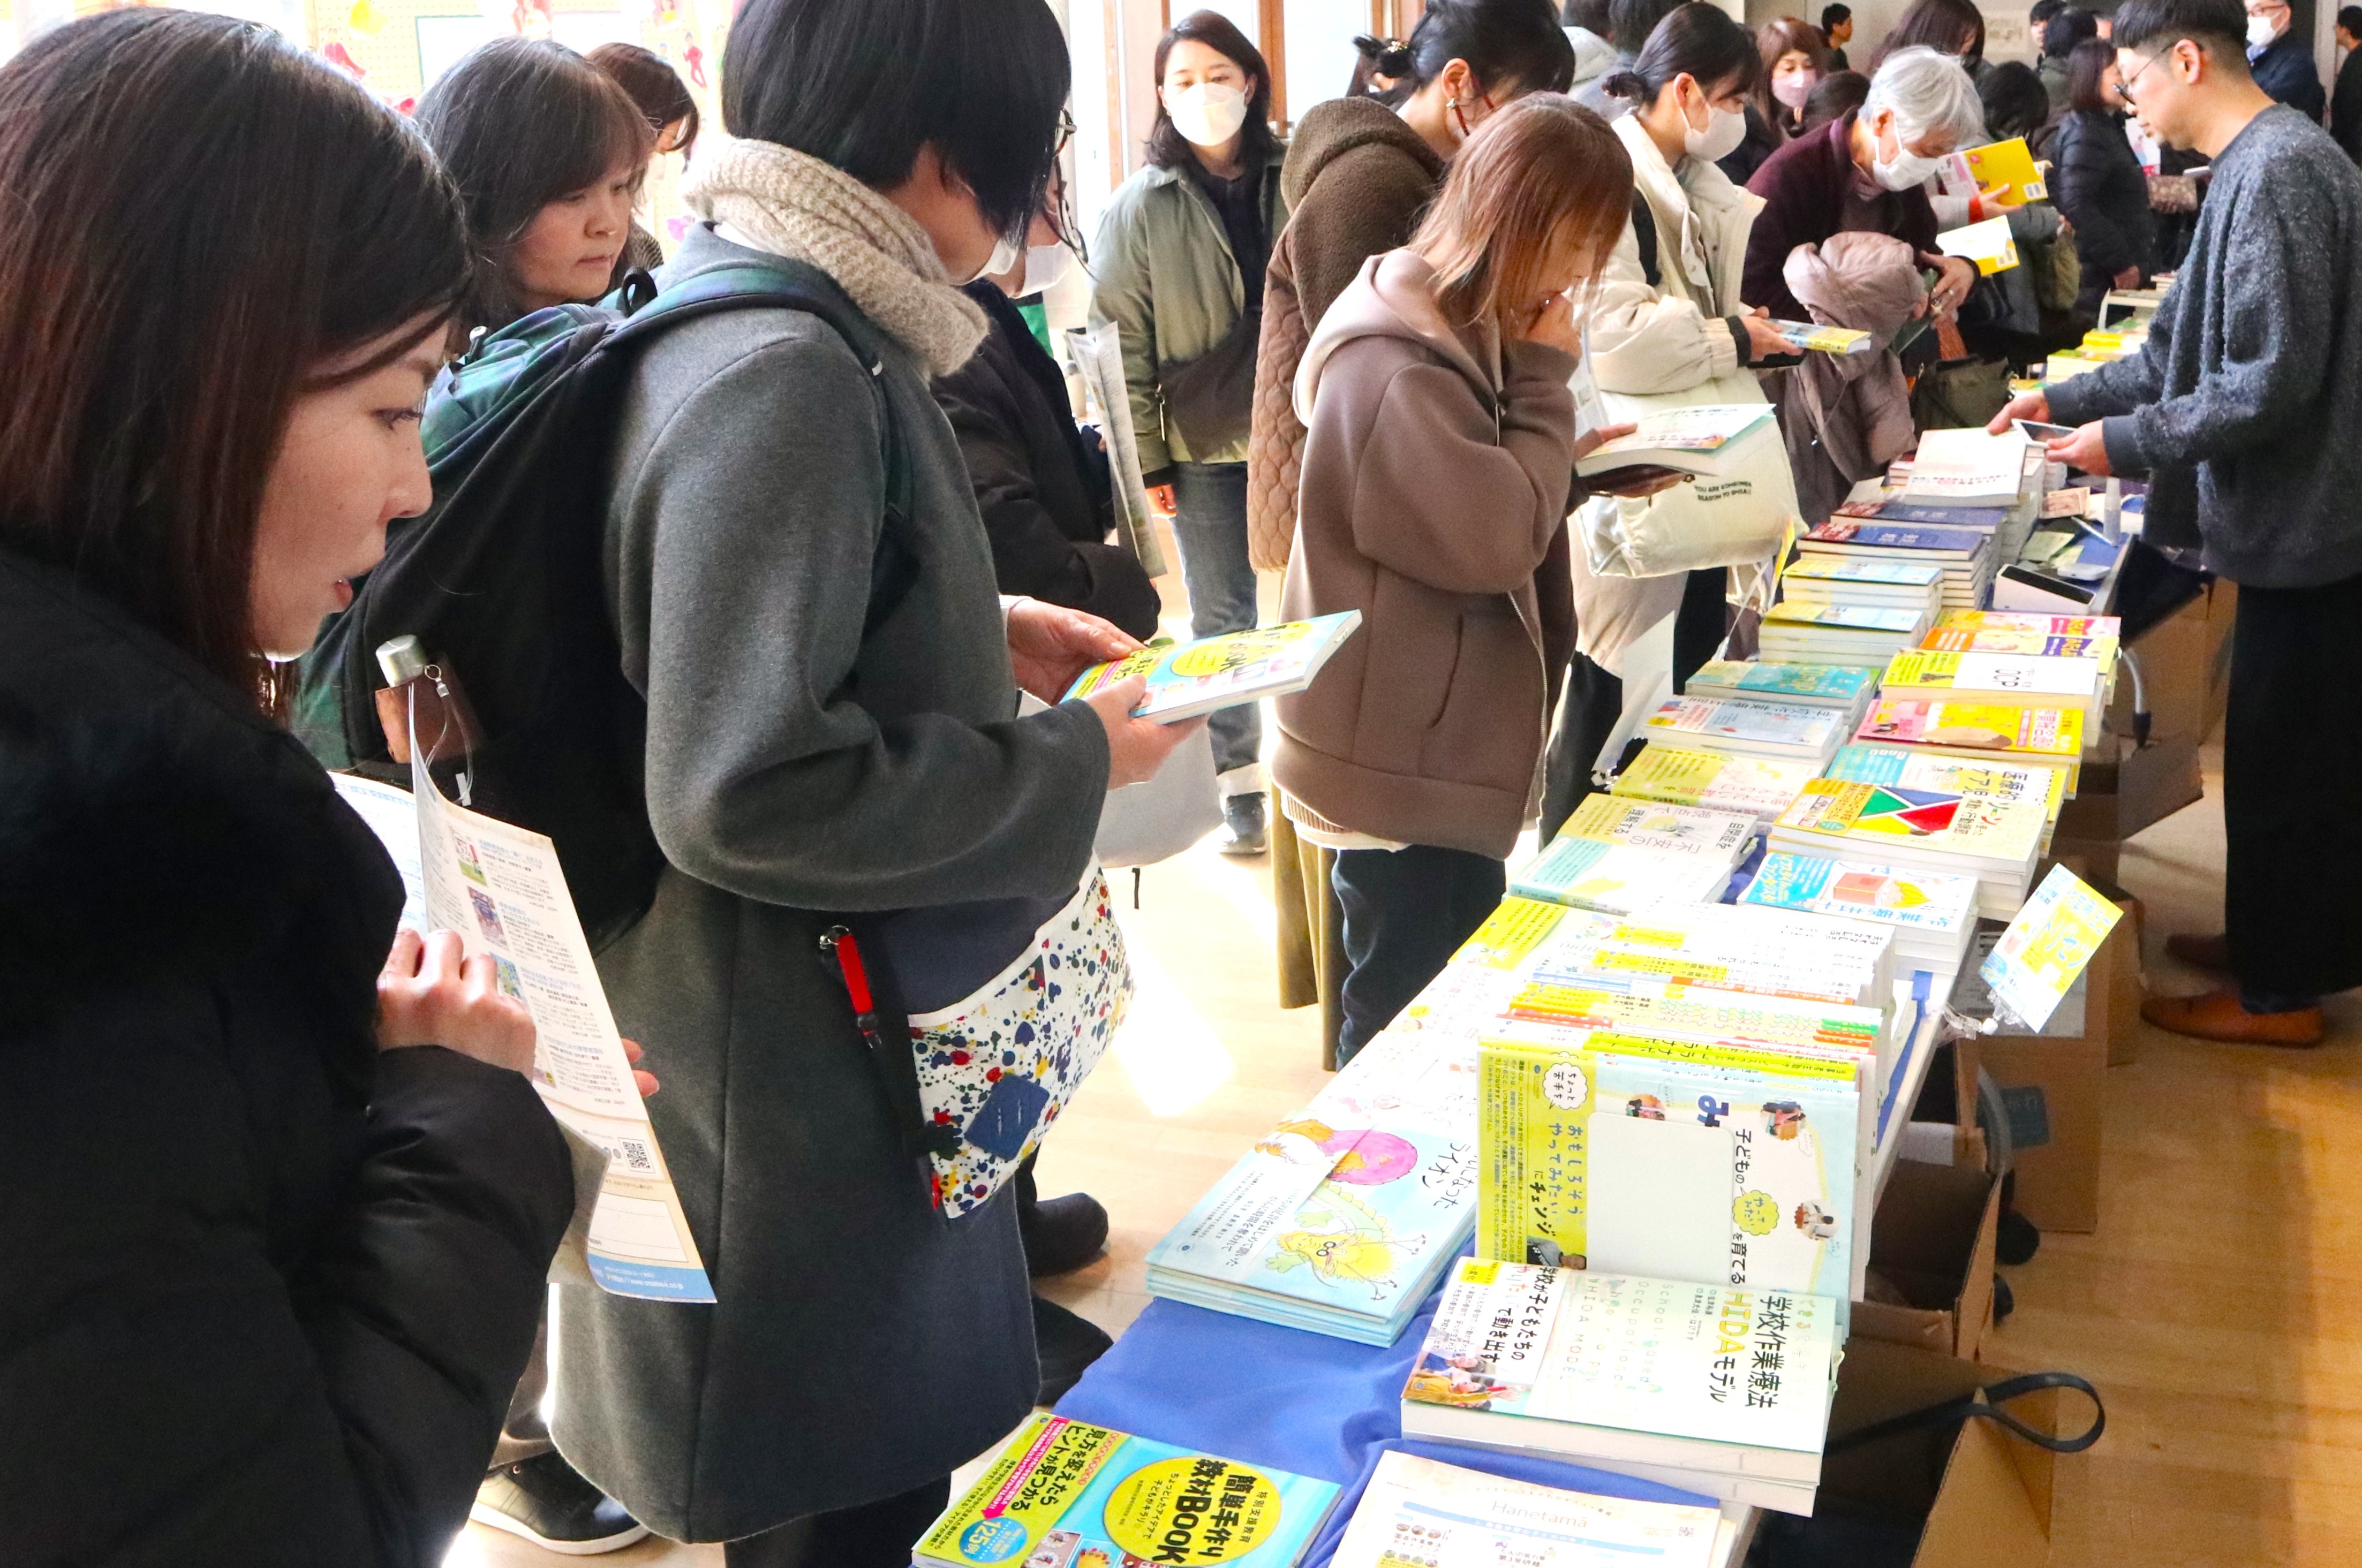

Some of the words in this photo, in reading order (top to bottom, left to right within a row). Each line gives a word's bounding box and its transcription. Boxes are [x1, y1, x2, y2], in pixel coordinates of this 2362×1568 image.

[1989, 668, 2023, 687] OCP
[1994, 771, 2029, 801] 医療的
[1612, 809, 1647, 834] 理解する
[1714, 822, 1746, 849] 自閉症を
[1552, 1070, 1564, 1099] 苦手を
[1567, 1073, 1576, 1101] ちょっと
[1422, 1143, 1473, 1188] ライオン
[1734, 1127, 1750, 1184] 子どもの
[1529, 1171, 1555, 1236] にチェンジ
[1743, 1200, 1754, 1227] みたい
[1753, 1197, 1765, 1223] やって
[1731, 1232, 1746, 1285] を育てる
[1510, 1266, 1558, 1362] 学校が子どもたちの
[1705, 1290, 1755, 1404] HIDAモデル
[1742, 1294, 1793, 1411] 学校作業療法
[1008, 1424, 1086, 1512] ヒントが見つかる
[1037, 1428, 1107, 1506] 見方を変えたら
[1141, 1473, 1180, 1539] ちょっとしたアイデアで
[1152, 1458, 1227, 1566] 教材BOOK
[1196, 1474, 1258, 1557] 簡単手作り
[1237, 1491, 1269, 1542] 特別支援教育
